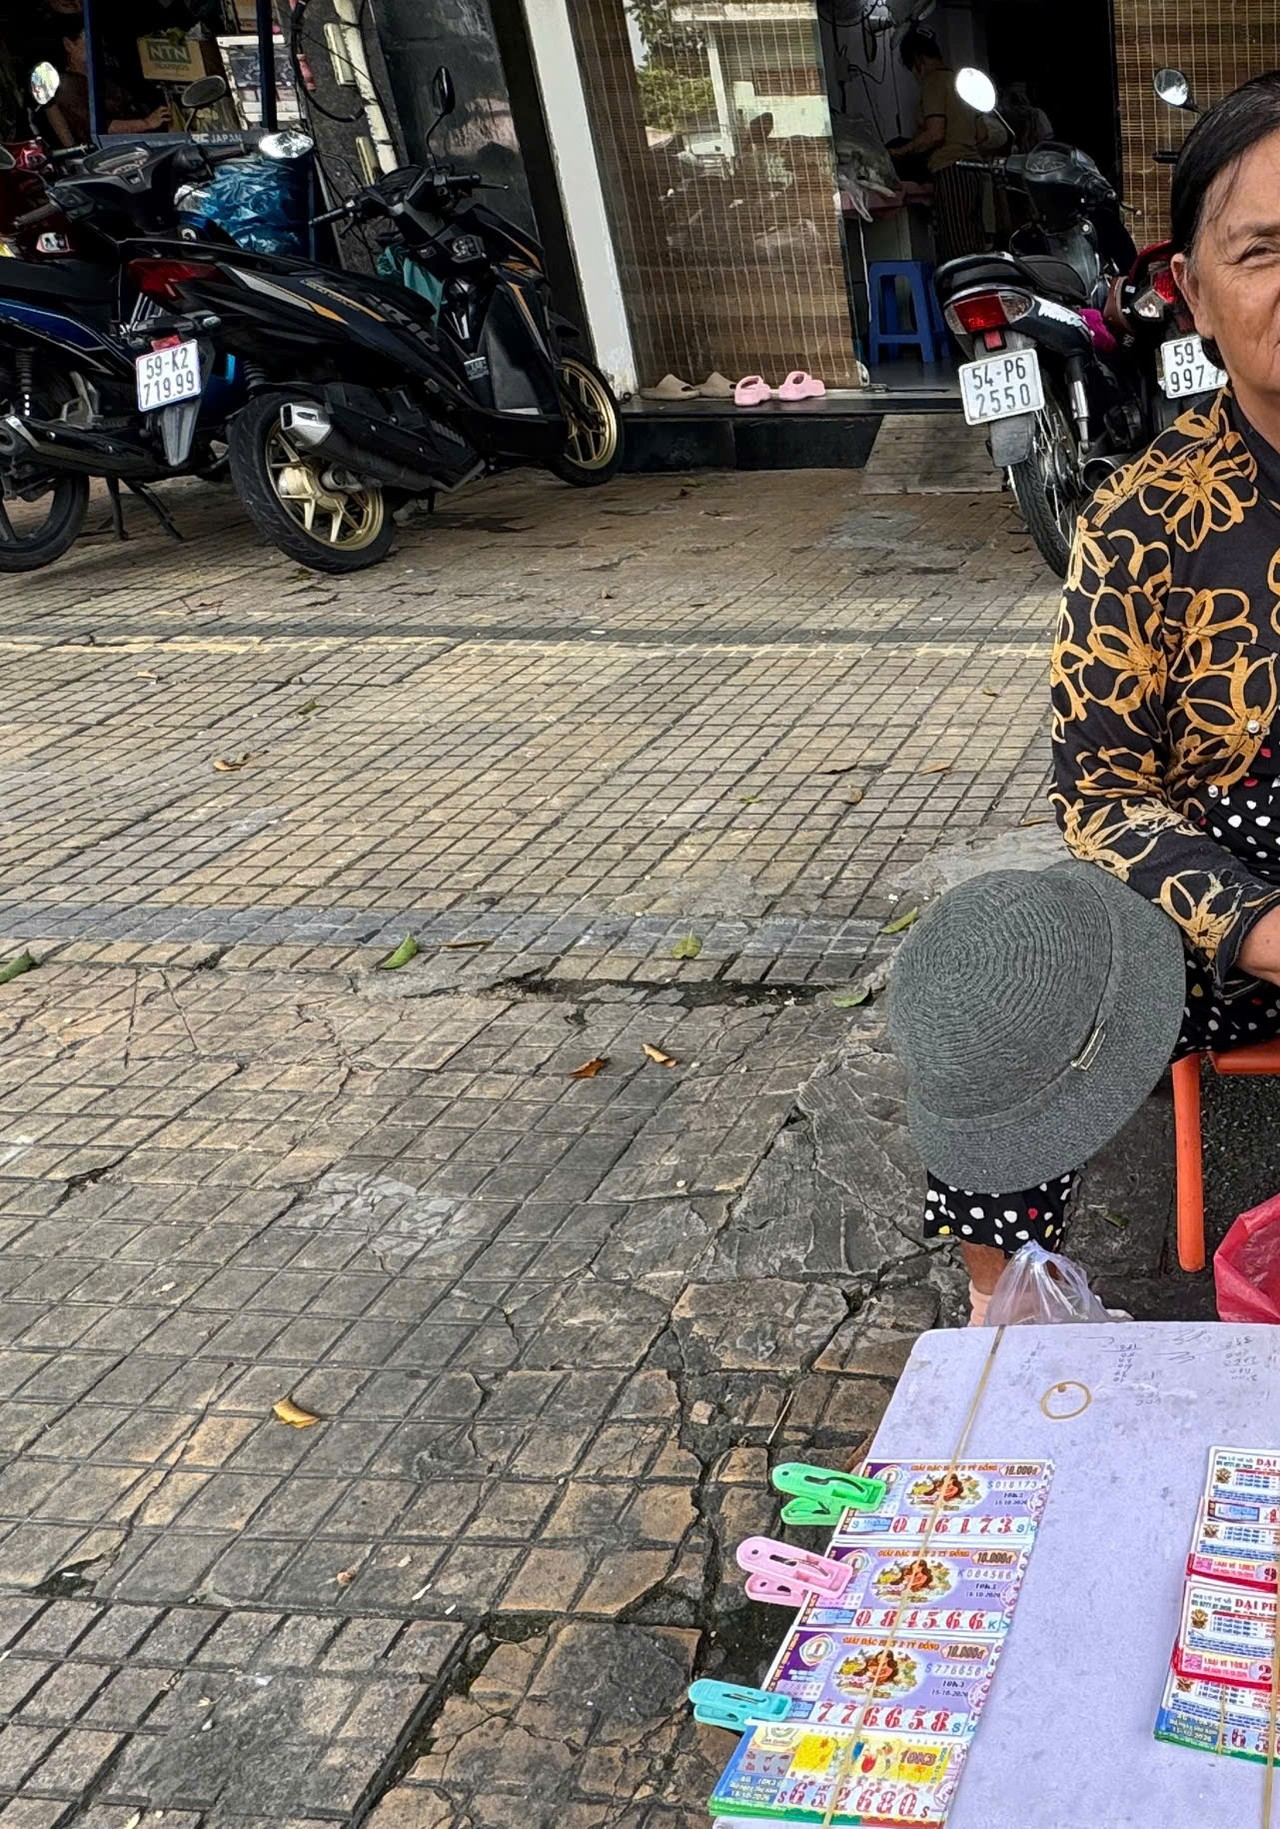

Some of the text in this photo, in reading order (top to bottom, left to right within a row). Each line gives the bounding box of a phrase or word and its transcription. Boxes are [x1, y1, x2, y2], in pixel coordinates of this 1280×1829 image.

[146, 347, 188, 379] 59-K2
[972, 357, 1026, 390] 54-P6
[143, 370, 194, 405] 719.99
[975, 383, 1030, 418] 2550
[1235, 1598, 1259, 1610] ĐẠI
